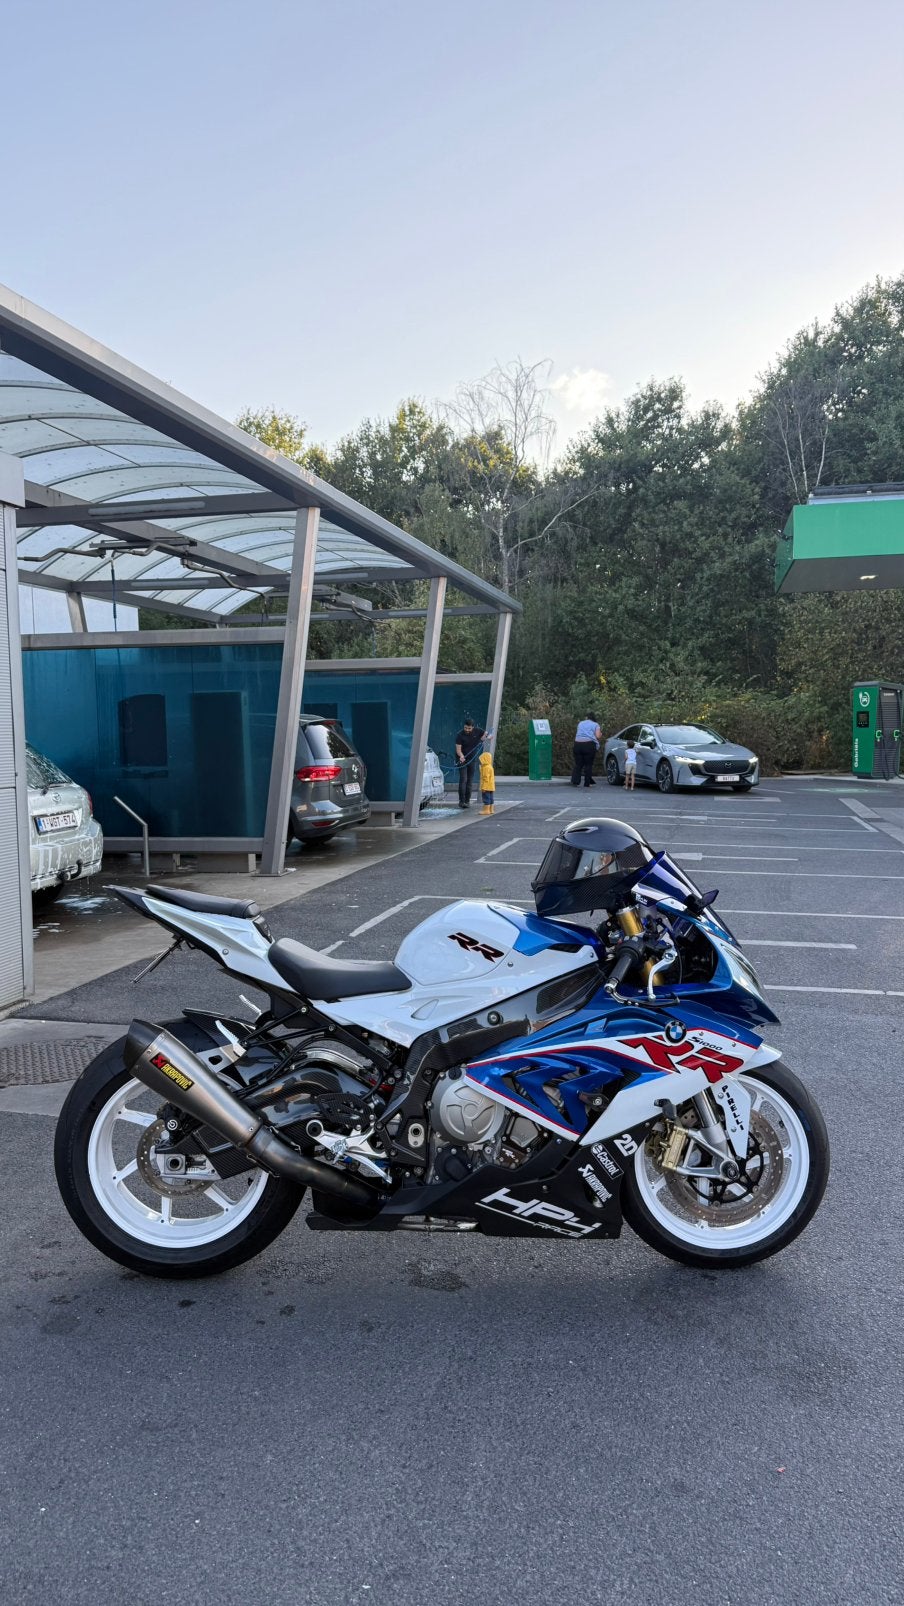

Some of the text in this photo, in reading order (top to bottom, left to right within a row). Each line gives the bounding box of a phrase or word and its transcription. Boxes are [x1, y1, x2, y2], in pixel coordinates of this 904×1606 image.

[447, 931, 505, 963] RR
[616, 1034, 744, 1084] RR
[687, 1036, 723, 1051] S1000
[721, 1084, 744, 1131] PIRELLI
[597, 1151, 620, 1177] Castrol
[480, 1187, 602, 1234] HP4
